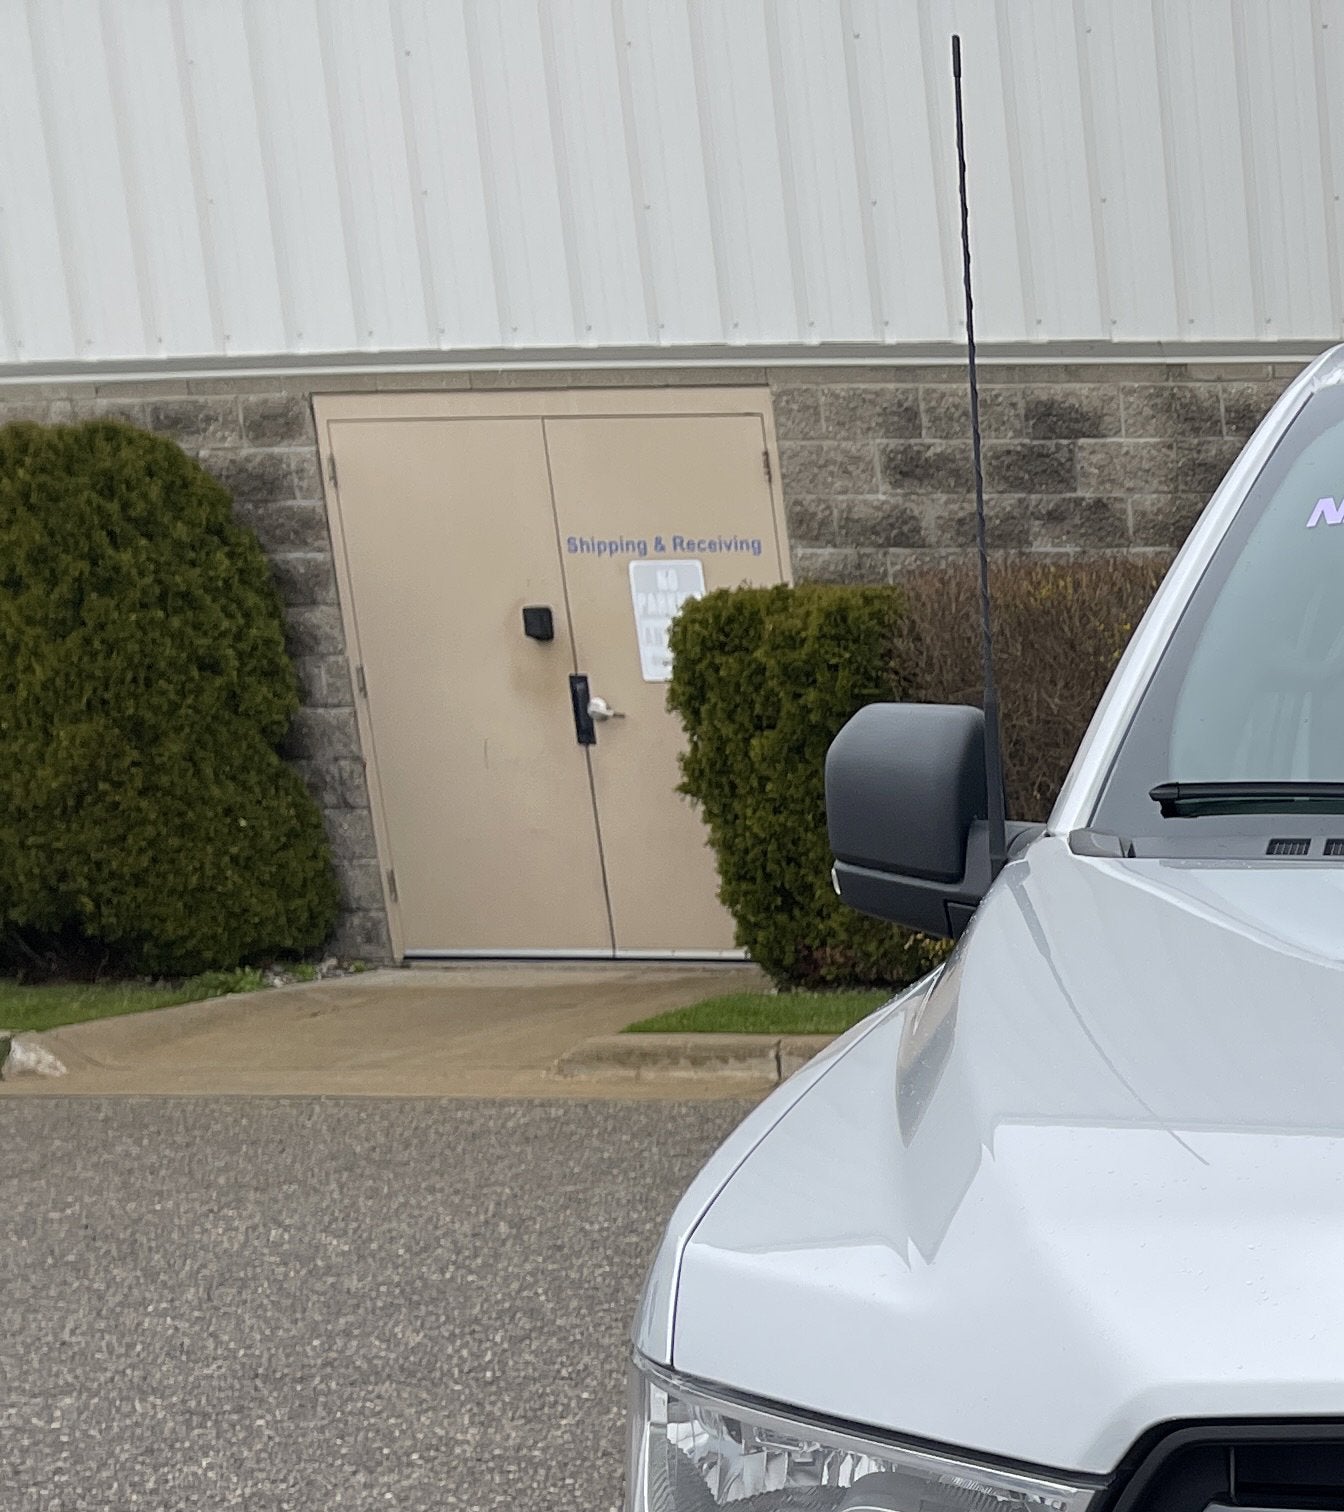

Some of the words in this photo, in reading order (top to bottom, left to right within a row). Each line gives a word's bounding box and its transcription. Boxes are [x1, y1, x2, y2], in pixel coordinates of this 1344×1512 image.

[567, 536, 647, 557] Shipping
[654, 536, 666, 553] &
[672, 535, 762, 556] Receiving
[656, 568, 679, 591] NO
[636, 591, 686, 615] PARK
